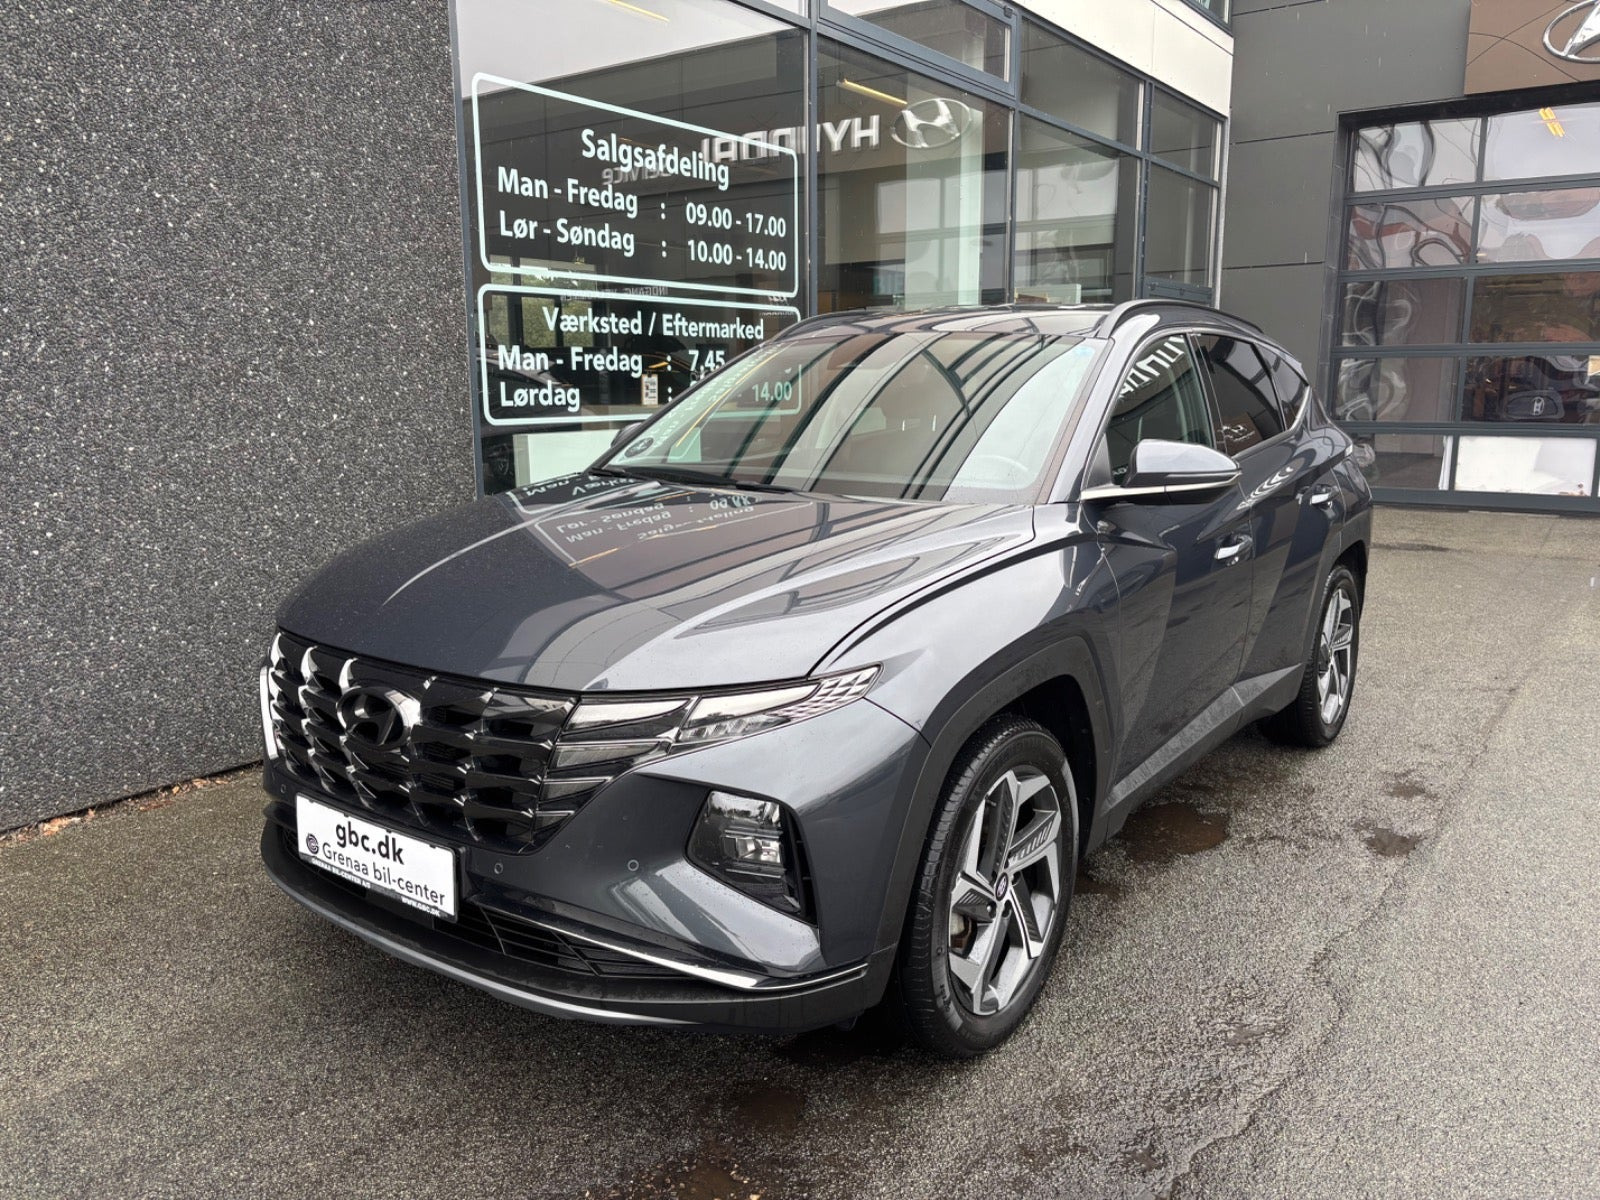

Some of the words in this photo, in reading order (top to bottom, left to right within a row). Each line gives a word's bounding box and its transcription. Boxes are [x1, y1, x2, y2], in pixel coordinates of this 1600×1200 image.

[581, 129, 729, 191] Salgsafdeling
[498, 166, 548, 199] Man
[568, 178, 638, 218] Fredag
[686, 202, 732, 230] 09.00
[746, 213, 786, 237] 17.00
[500, 210, 538, 239] Lør
[557, 218, 634, 256] Søndag
[688, 240, 732, 265] 10.00
[746, 249, 786, 270] 14.00
[542, 307, 641, 335] Værksted
[662, 313, 764, 340] Eftermarked
[498, 345, 549, 371] Man
[571, 347, 642, 378] Fredag
[688, 349, 725, 371] 7.45
[500, 380, 580, 412] Lørdag
[752, 381, 793, 401] 14.00
[336, 821, 404, 865] gbc.dk
[322, 842, 369, 876] Grenaa
[373, 862, 446, 906] bil-center
